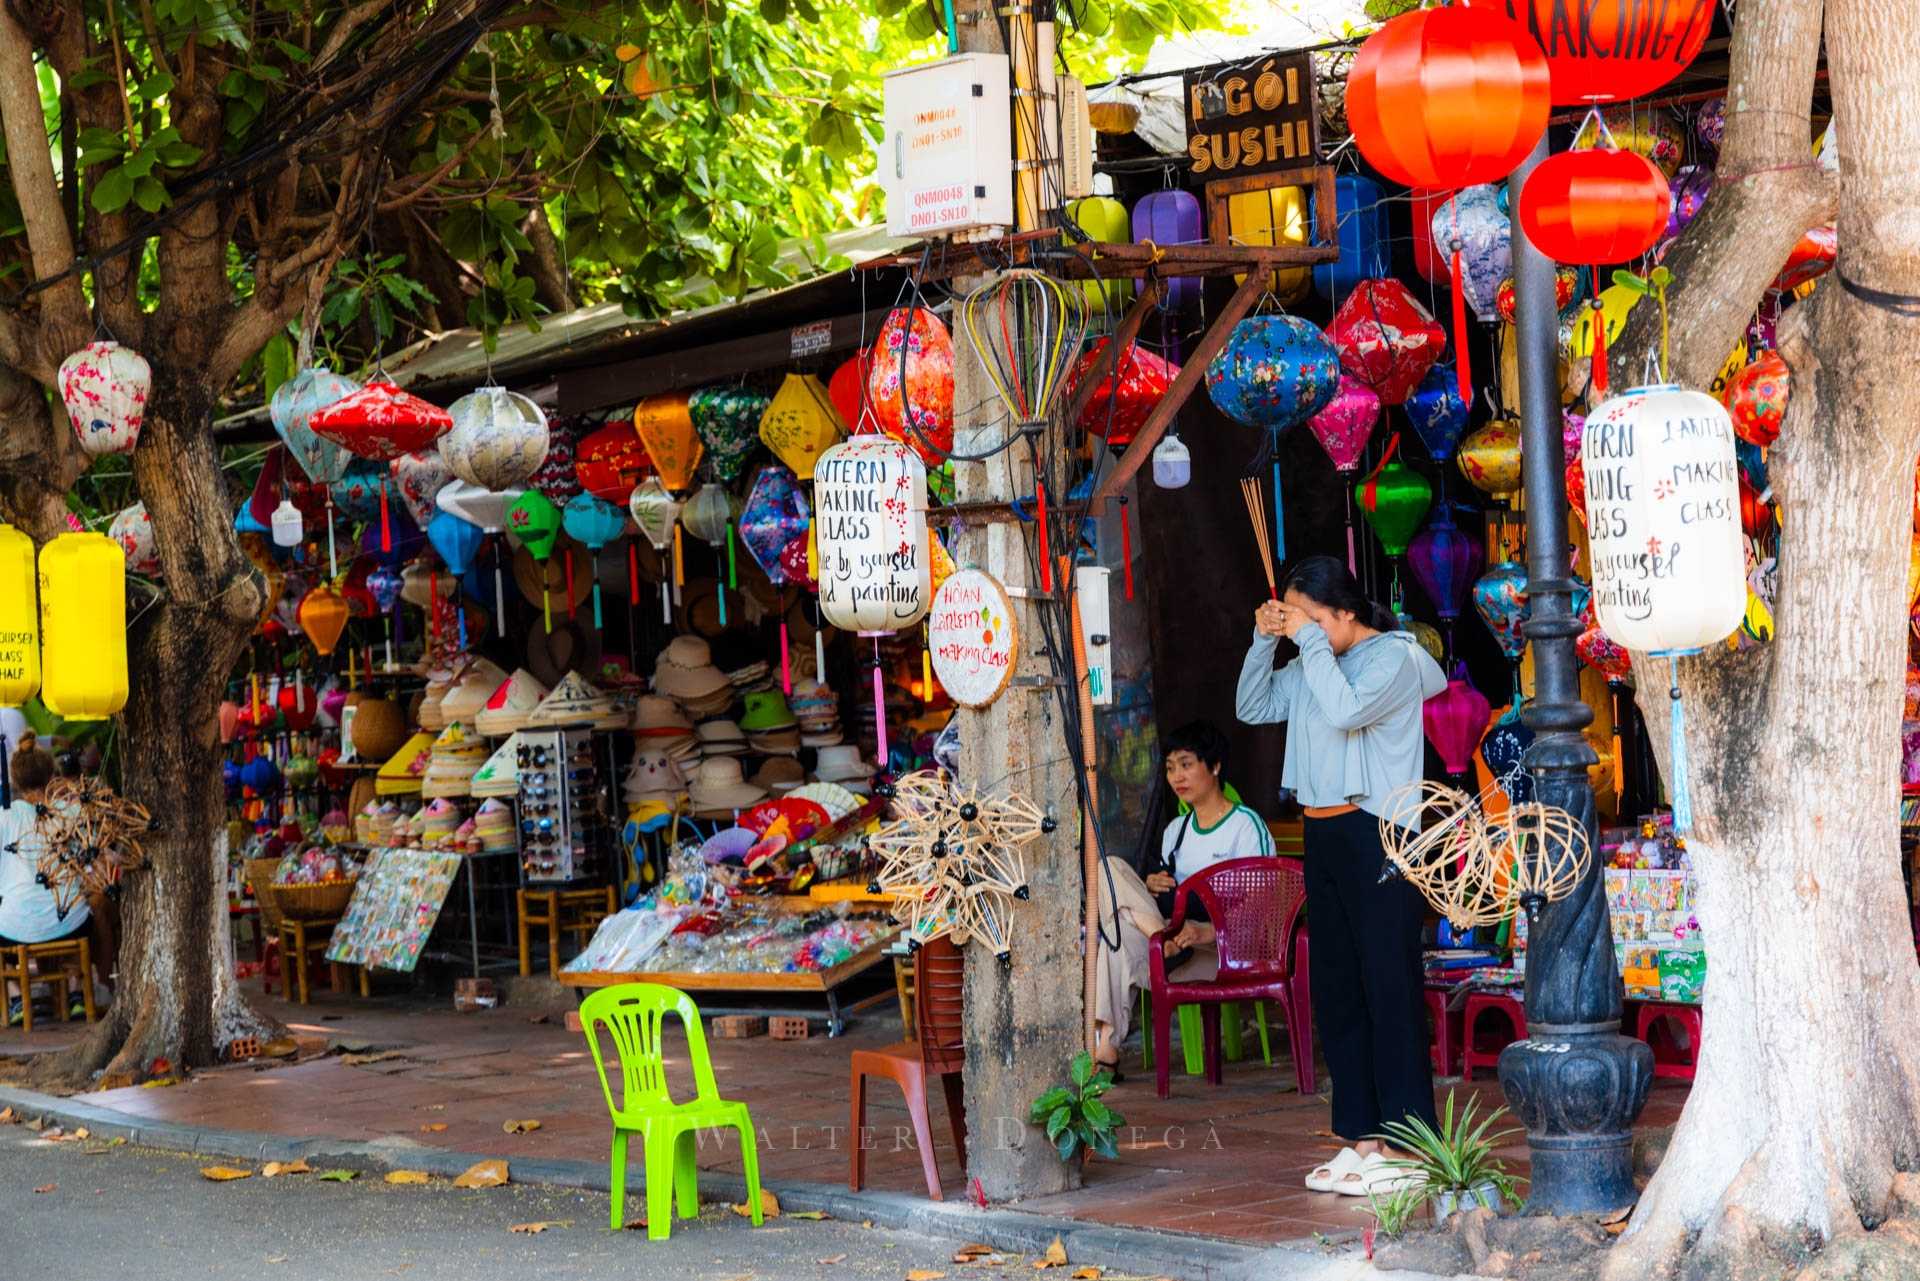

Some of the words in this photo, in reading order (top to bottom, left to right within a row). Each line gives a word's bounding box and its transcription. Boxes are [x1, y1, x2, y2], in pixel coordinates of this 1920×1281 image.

[1189, 120, 1311, 173] SUSHI
[914, 186, 963, 208] QNM0048
[820, 484, 882, 513] AKING
[851, 574, 920, 618] painting
